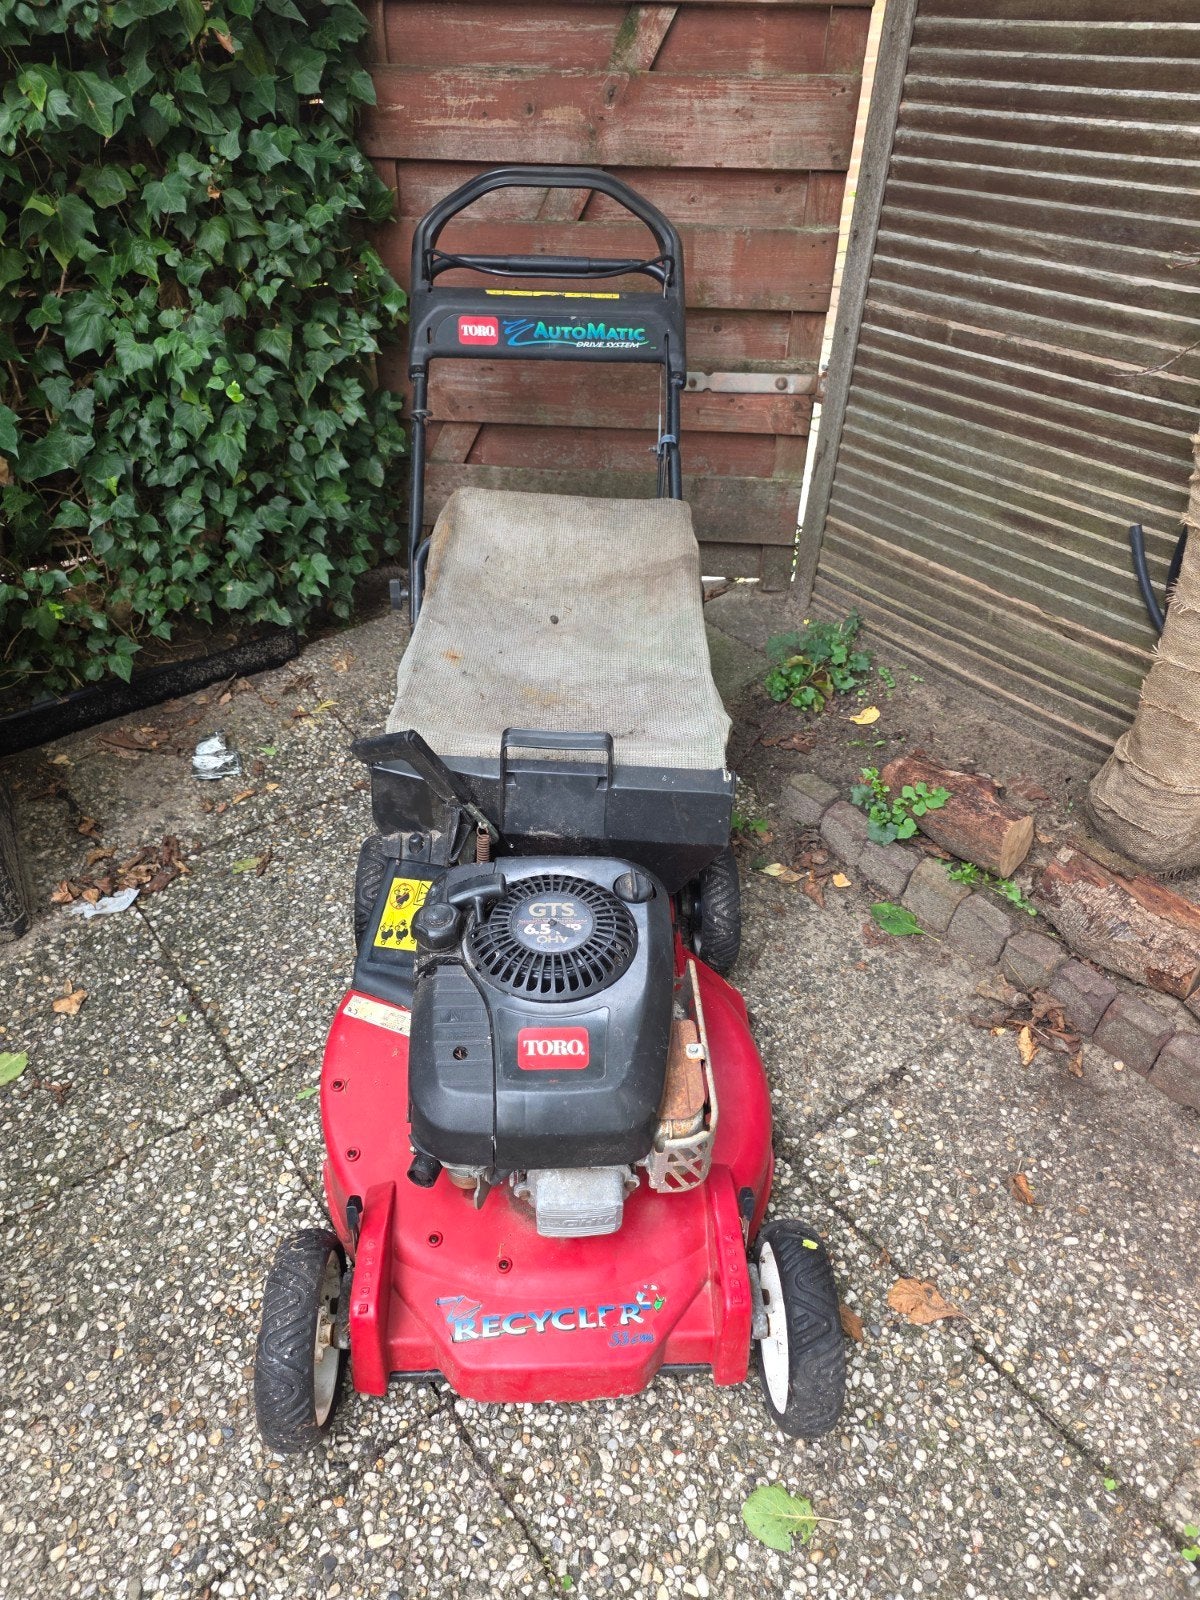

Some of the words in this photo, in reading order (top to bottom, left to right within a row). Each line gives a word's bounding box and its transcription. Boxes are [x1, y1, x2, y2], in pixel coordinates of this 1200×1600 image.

[606, 341, 640, 349] SYSTEM
[523, 923, 551, 935] 6.5
[536, 935, 568, 944] OHV
